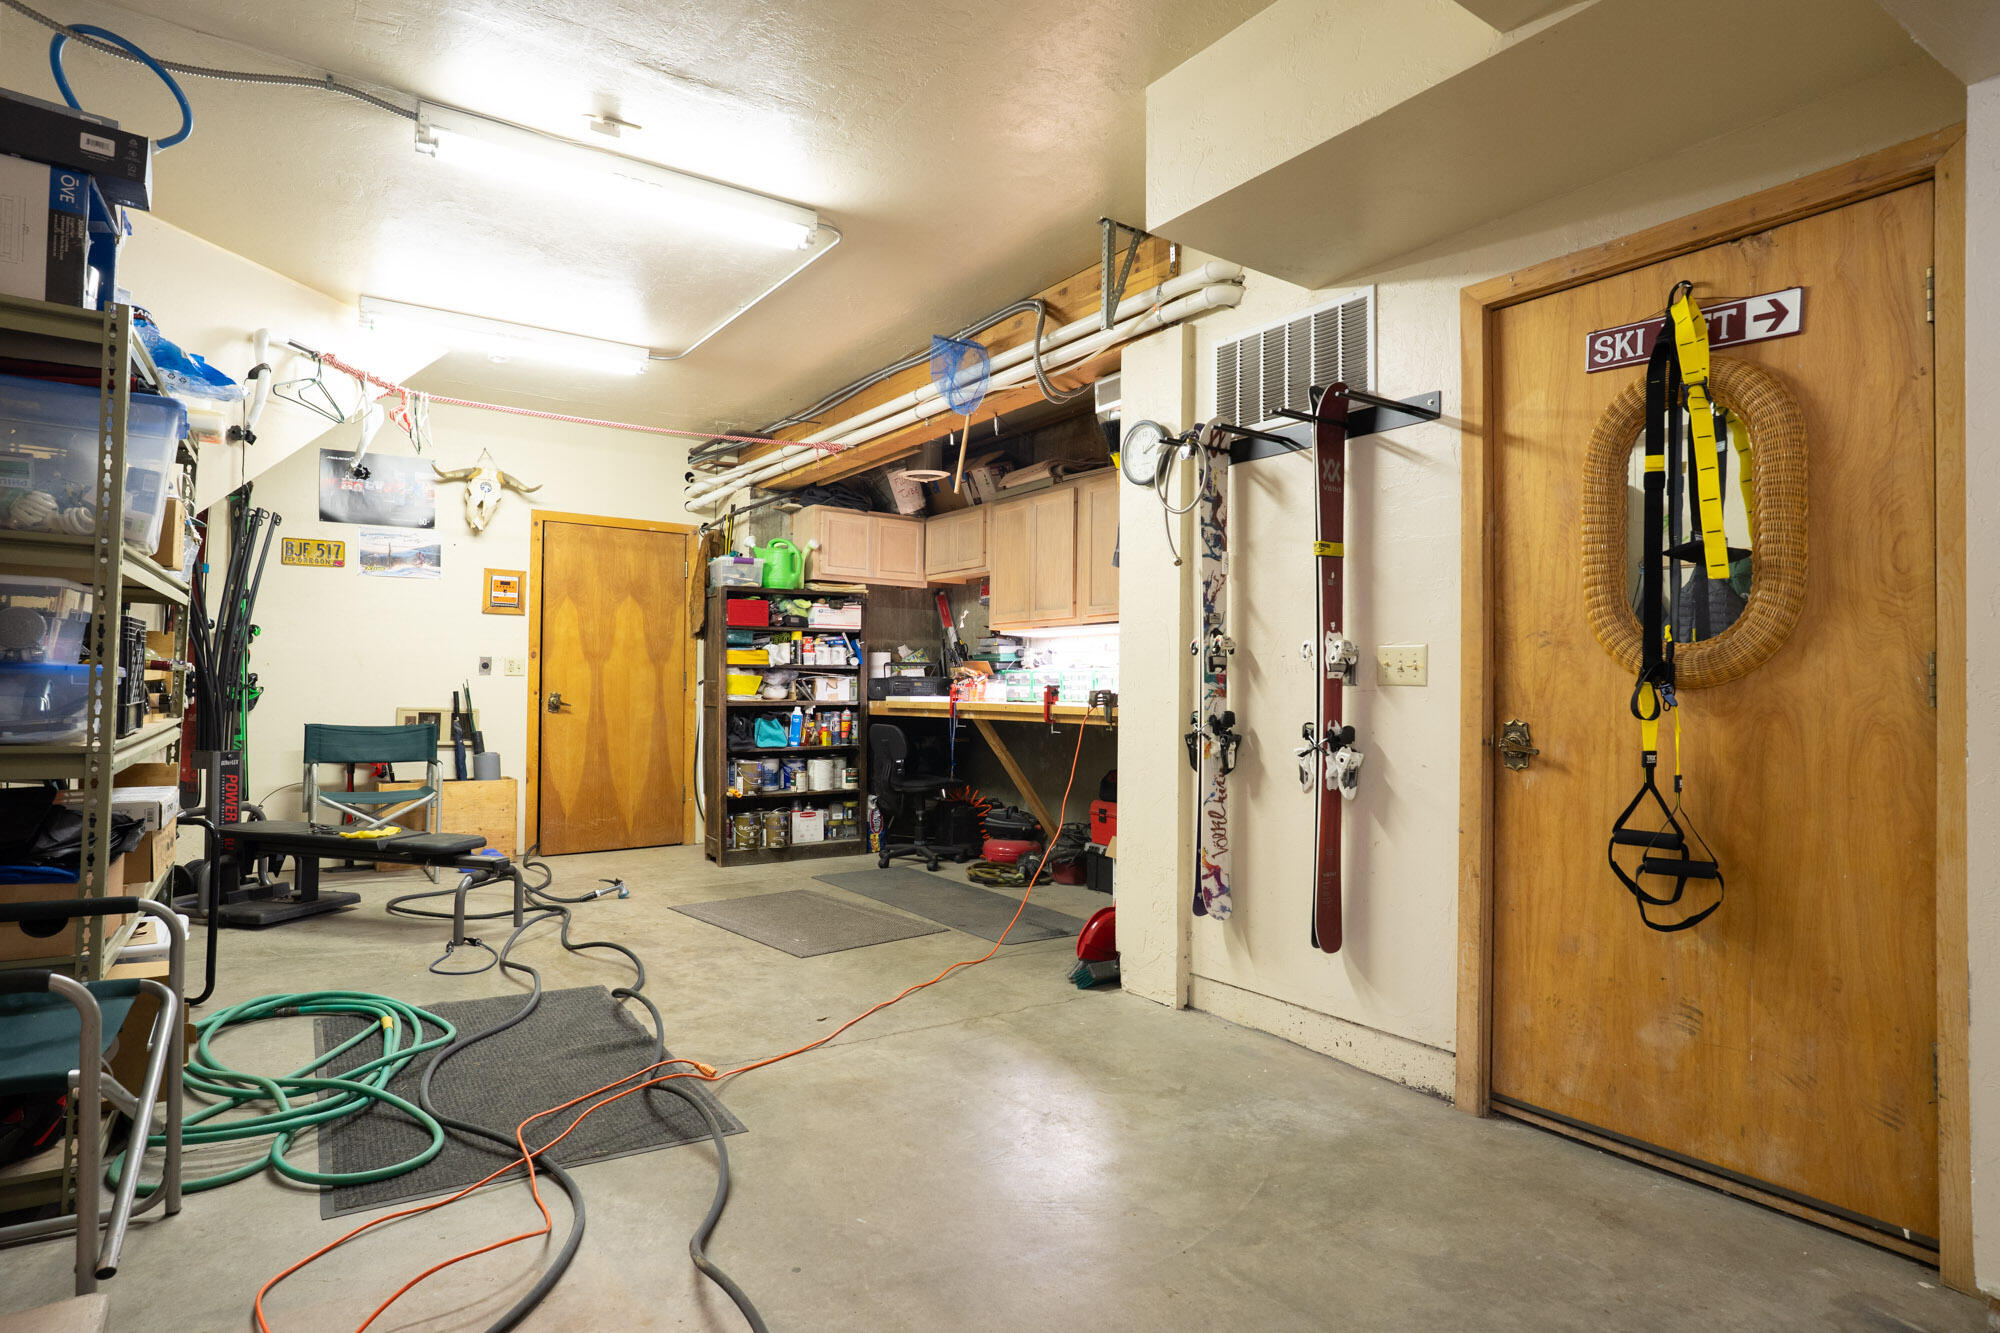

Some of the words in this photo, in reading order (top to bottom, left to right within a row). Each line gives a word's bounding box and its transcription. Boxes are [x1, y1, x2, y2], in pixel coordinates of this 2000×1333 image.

[1593, 327, 1646, 363] SKI
[285, 541, 310, 557] BJF
[317, 543, 341, 559] 517
[297, 557, 331, 565] OREGON
[224, 774, 239, 822] POWER
